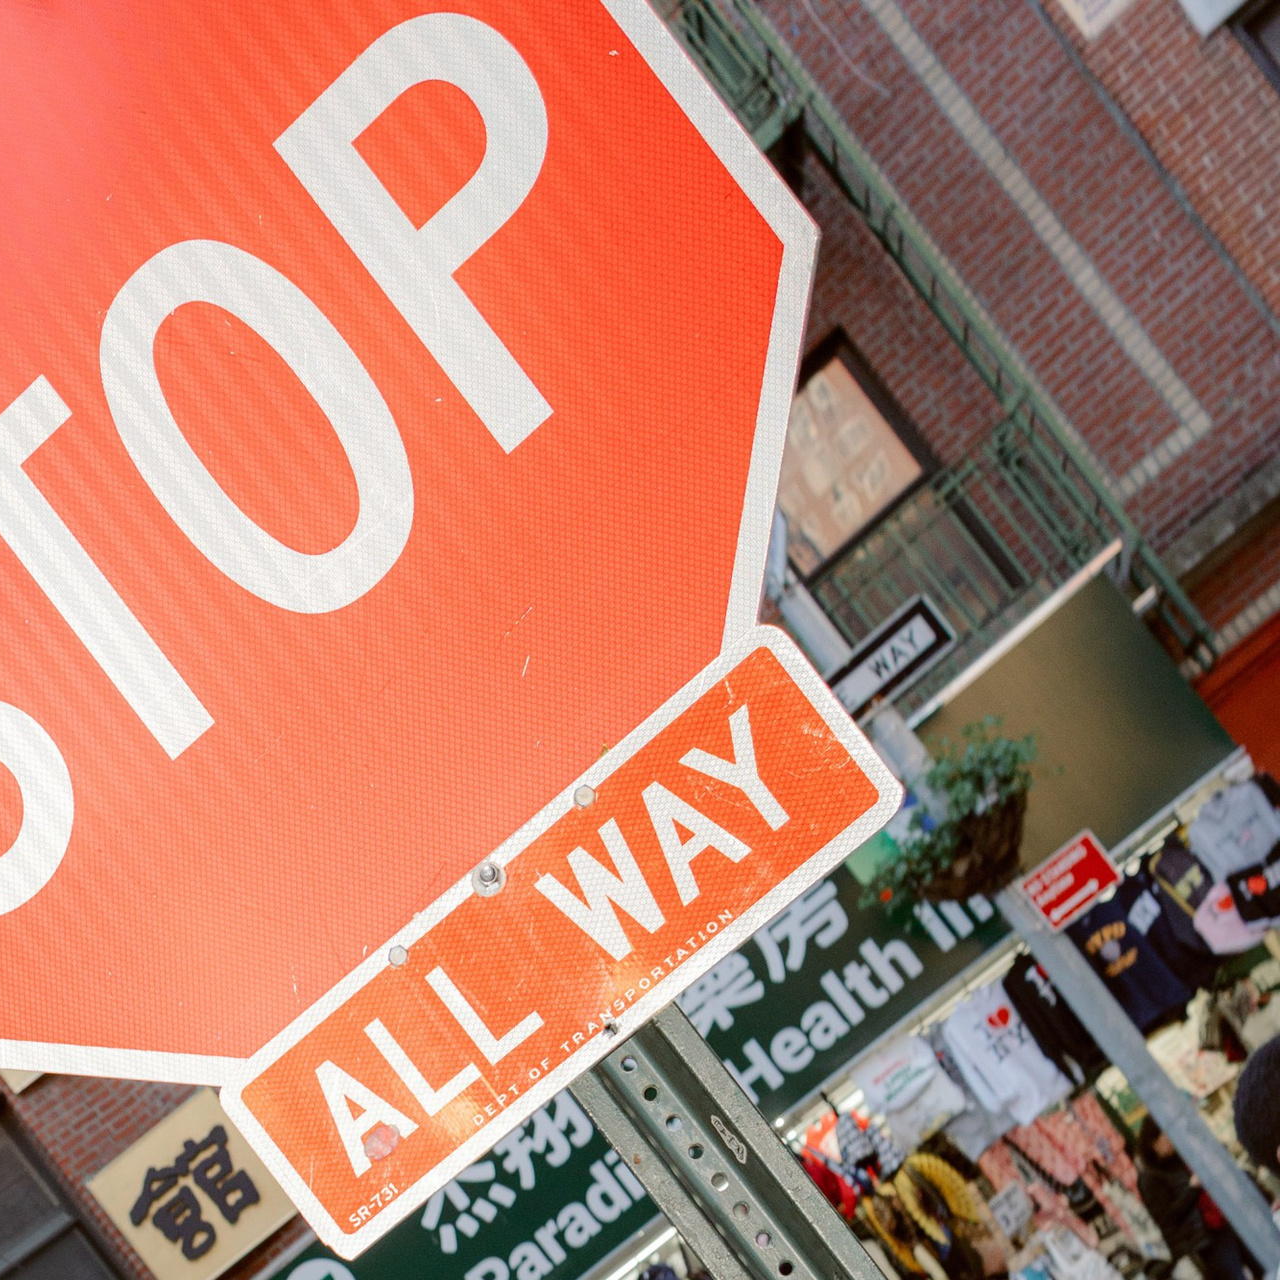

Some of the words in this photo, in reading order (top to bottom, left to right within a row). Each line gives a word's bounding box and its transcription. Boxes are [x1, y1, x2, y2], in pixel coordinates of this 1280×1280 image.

[870, 629, 918, 677] WAY
[314, 965, 545, 1178] ALL
[533, 704, 790, 962] WAY
[472, 1084, 520, 1127] DEPT
[528, 1057, 551, 1080] OF
[559, 907, 734, 1053] TRANSPORTATION
[723, 936, 924, 1105] Health
[913, 892, 995, 952] In
[128, 1124, 262, 1261] 館
[348, 1182, 400, 1229] SR-731
